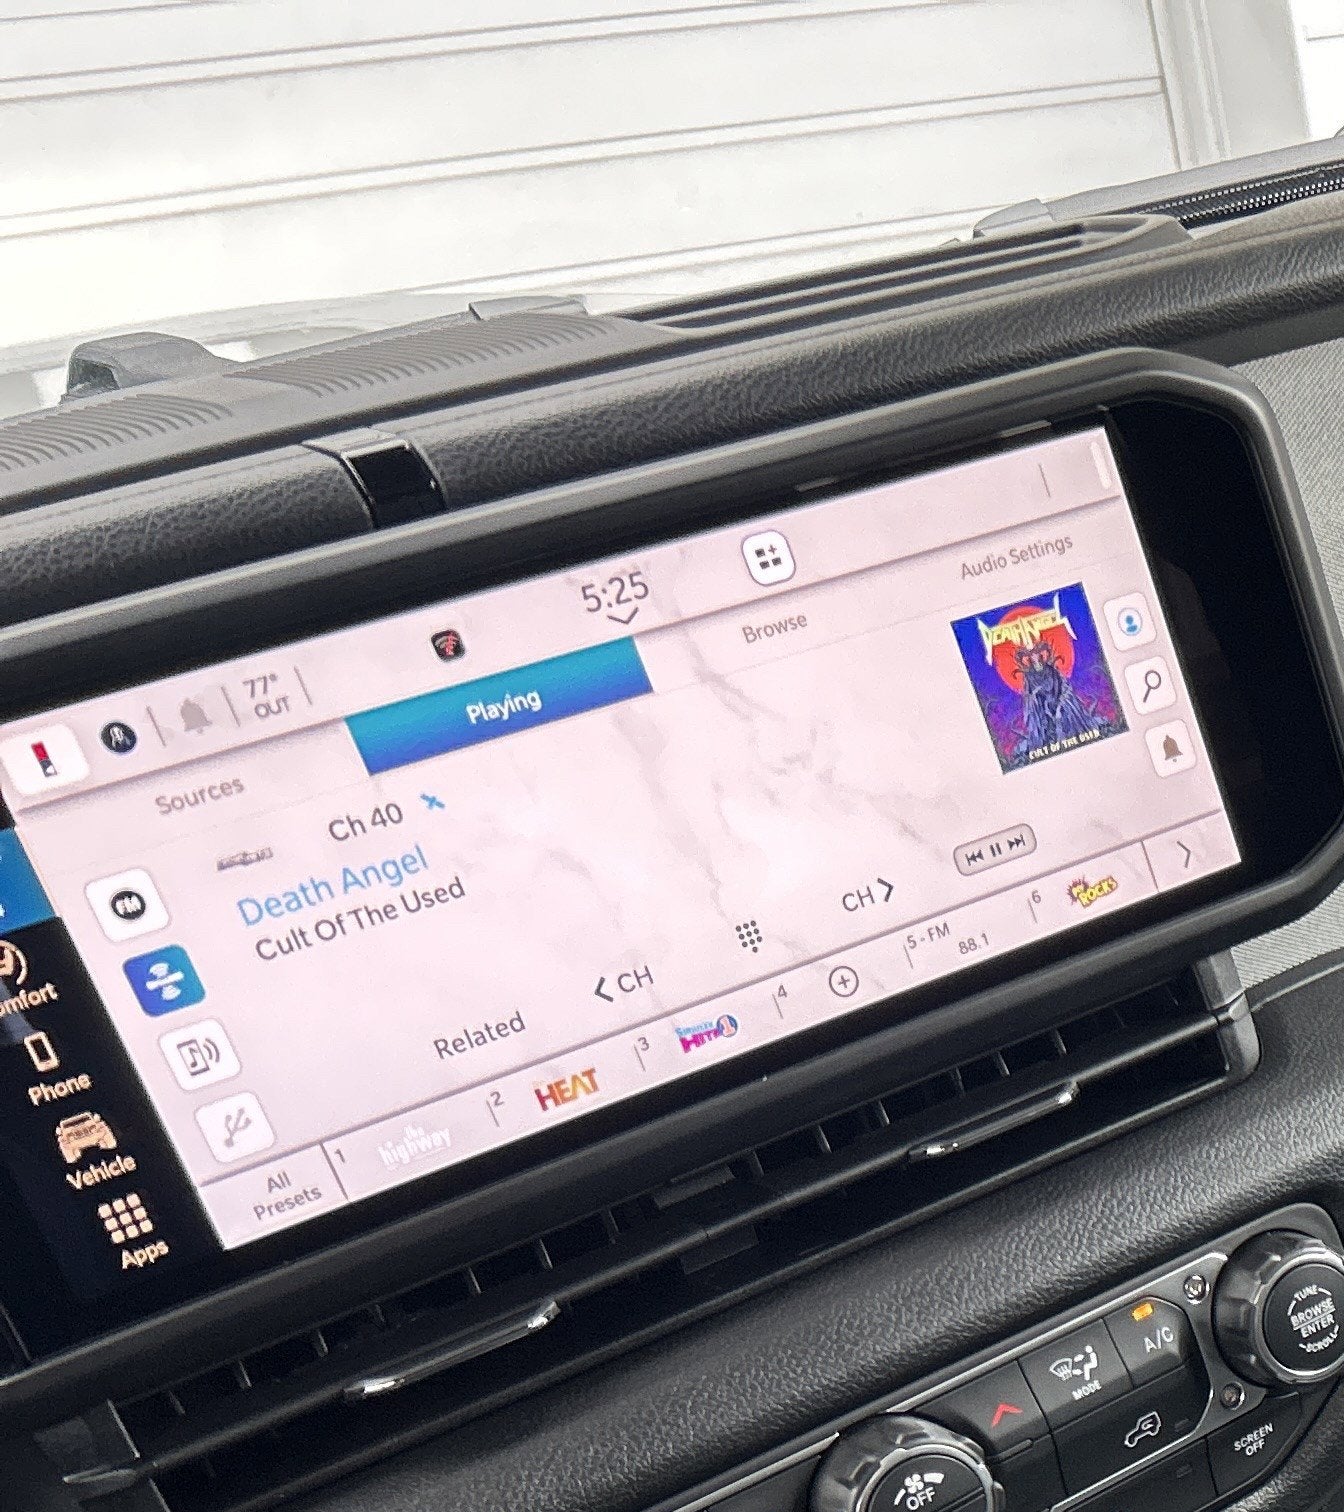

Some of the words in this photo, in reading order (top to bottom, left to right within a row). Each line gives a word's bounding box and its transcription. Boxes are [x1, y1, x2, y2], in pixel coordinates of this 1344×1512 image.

[960, 550, 1008, 580] Audio
[1009, 533, 1073, 576] Settings
[582, 572, 650, 614] 5:25
[741, 612, 808, 645] Browse
[242, 673, 278, 698] 77°
[254, 695, 290, 718] OUT
[466, 688, 543, 725] Playing
[155, 775, 245, 816] Sources
[328, 815, 367, 842] Ch
[371, 803, 404, 827] 40
[236, 877, 336, 927] Death
[342, 843, 429, 894] Angel
[1031, 889, 1042, 904] 6
[840, 884, 876, 915] CH
[255, 928, 313, 961] Cult
[314, 913, 347, 941] Of
[347, 904, 400, 930] The
[400, 876, 467, 914] Used
[927, 922, 950, 942] FM
[958, 932, 990, 955] 88.1
[616, 964, 655, 994] CH
[777, 984, 788, 998] 4
[433, 1010, 528, 1060] Related
[637, 1036, 650, 1051] 3
[29, 1071, 93, 1106] Phone
[490, 1090, 504, 1106] 2
[534, 1067, 600, 1112] HEAT
[334, 1149, 346, 1164] 1
[64, 1153, 138, 1191] Vehicle
[267, 1170, 291, 1194] All
[252, 1186, 322, 1221] Presets
[121, 1239, 170, 1270] Apps
[1294, 1284, 1319, 1302] TUNE
[1290, 1298, 1335, 1326] BROWSE
[1143, 1326, 1175, 1353] A/C
[1300, 1316, 1335, 1338] ENTER
[1306, 1332, 1338, 1352] SCROLL
[1072, 1380, 1102, 1400] MODE
[1233, 1423, 1274, 1452] SCREEN
[1245, 1439, 1265, 1456] OFF
[905, 1486, 936, 1511] OFF
